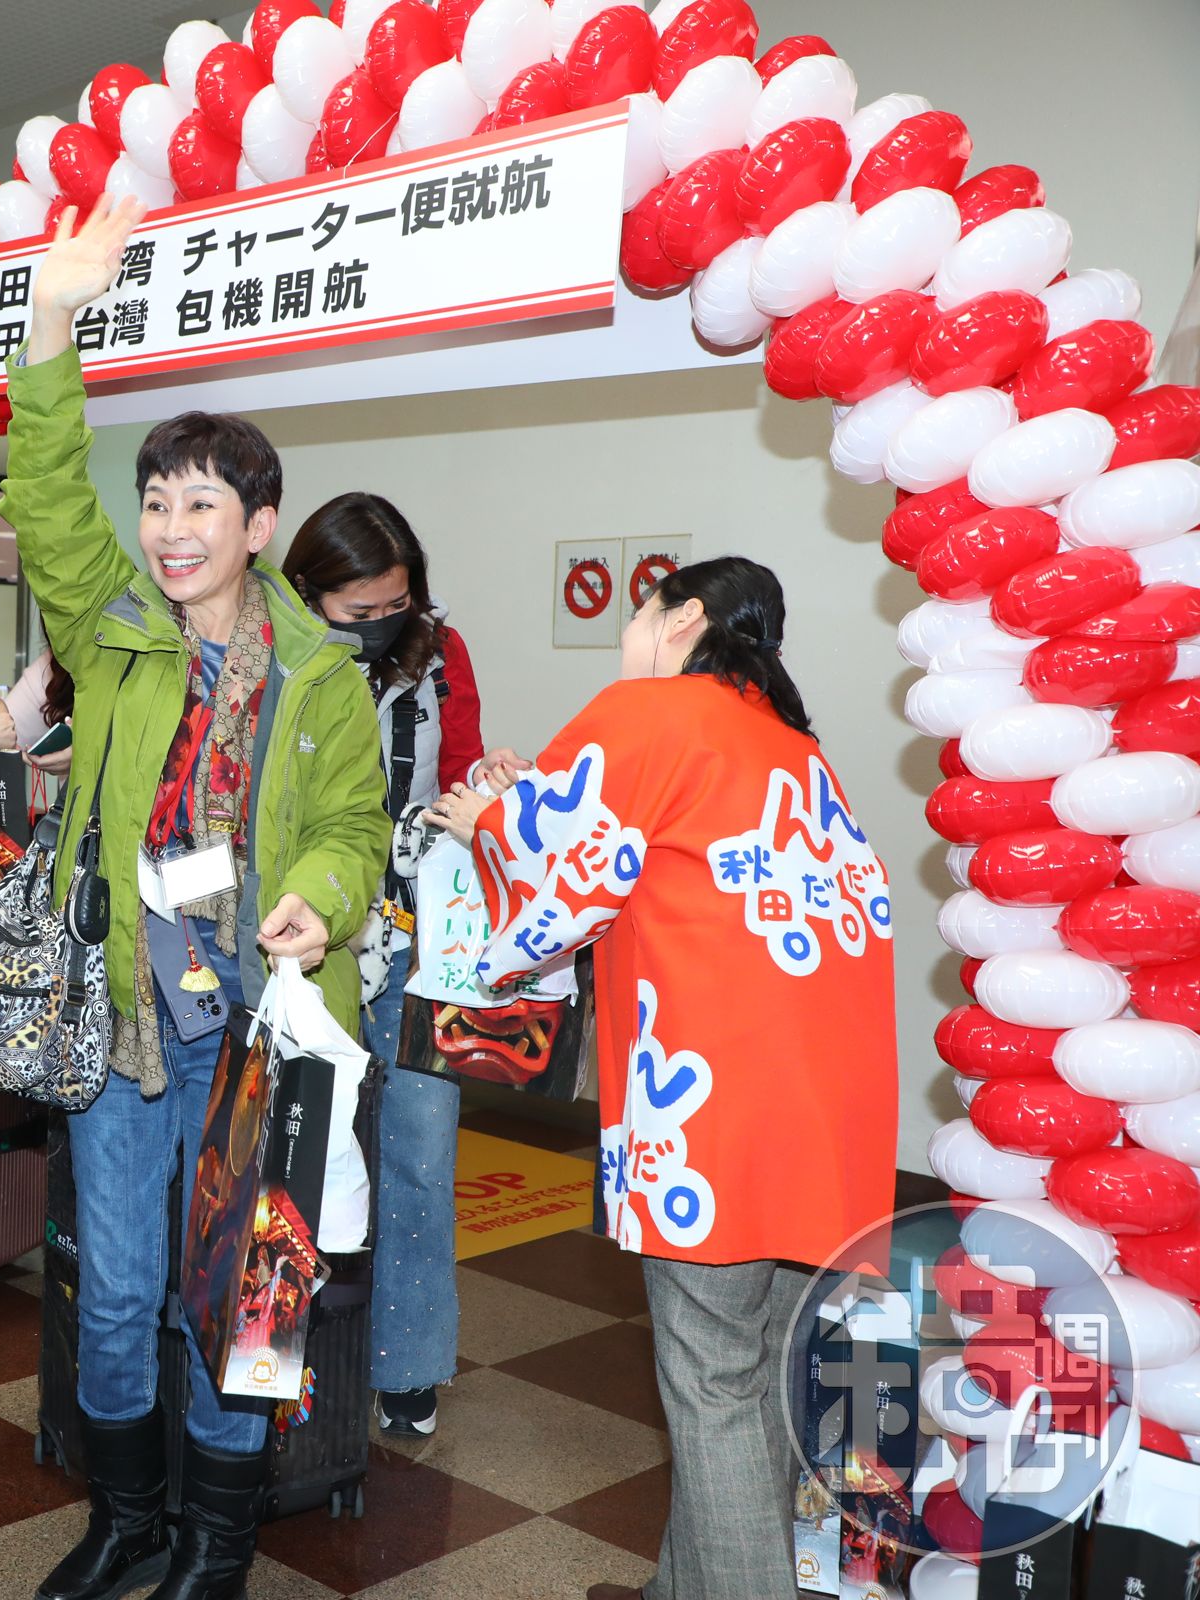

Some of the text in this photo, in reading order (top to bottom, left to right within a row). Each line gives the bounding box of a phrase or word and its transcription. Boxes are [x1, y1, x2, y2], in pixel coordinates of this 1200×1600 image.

[182, 154, 554, 275] チャーター便就航
[74, 297, 149, 353] 台灣
[174, 258, 370, 338] 包機開航
[286, 1102, 304, 1137] 秋田
[811, 1353, 822, 1380] 秋田
[876, 1381, 892, 1410] 秋田
[1015, 1552, 1036, 1591] 秋田
